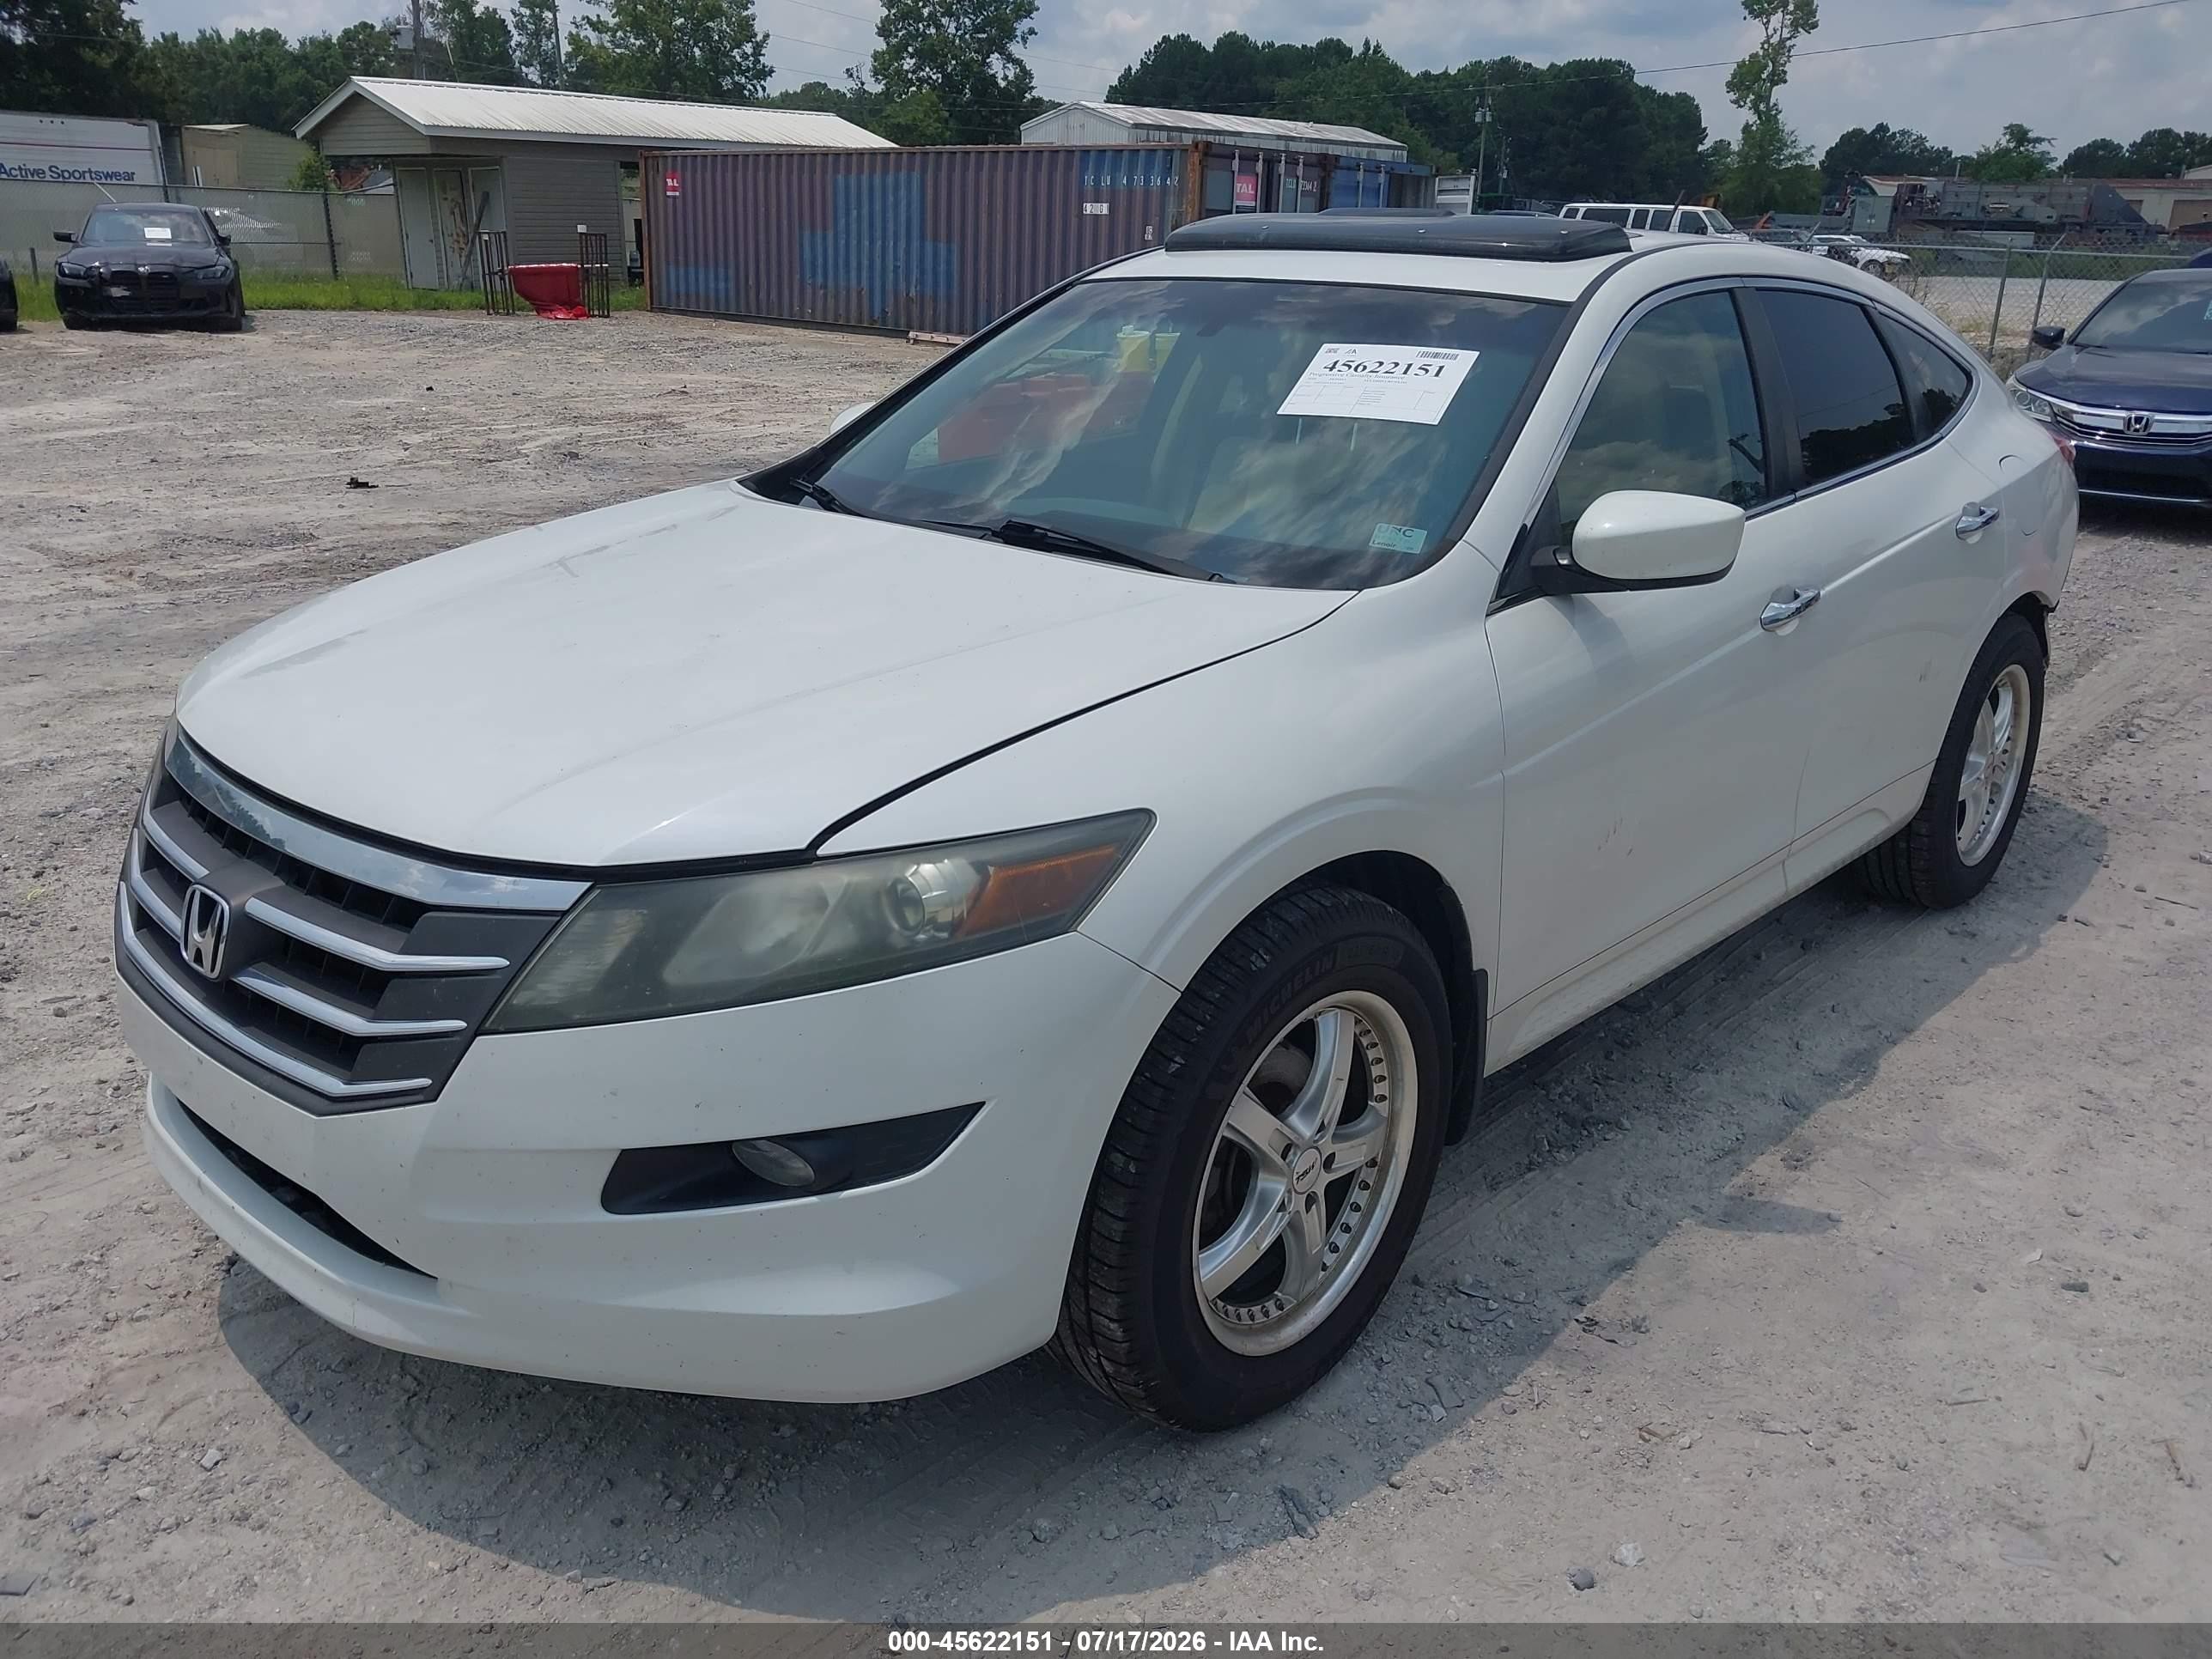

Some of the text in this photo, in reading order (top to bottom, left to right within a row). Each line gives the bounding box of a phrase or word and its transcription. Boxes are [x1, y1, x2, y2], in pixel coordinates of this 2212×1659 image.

[0, 162, 136, 181] Active Sportswear
[1236, 183, 1255, 194] TAL
[1323, 359, 1446, 378] 45622151
[1246, 952, 1336, 1043] MICHELIN
